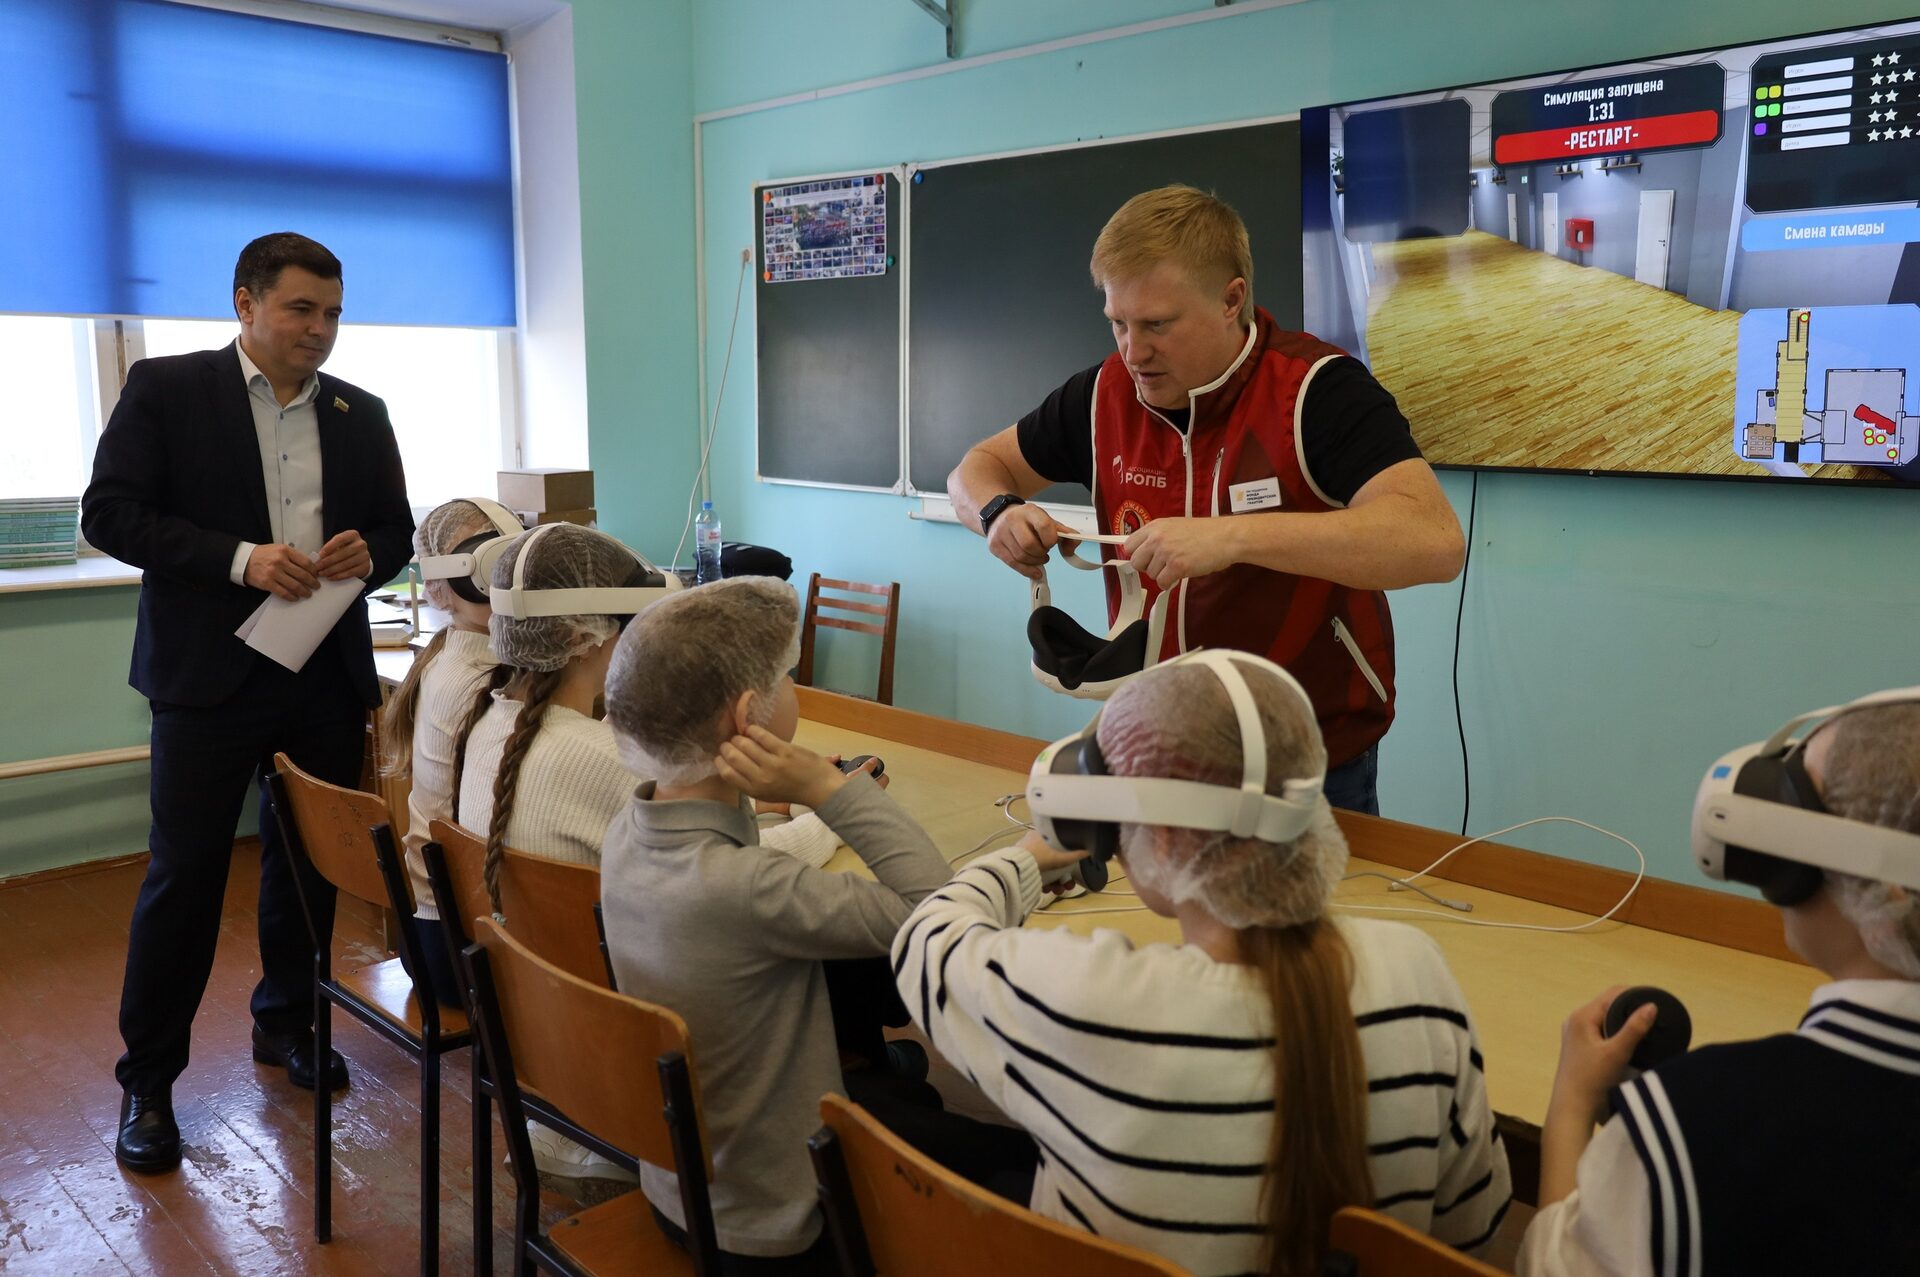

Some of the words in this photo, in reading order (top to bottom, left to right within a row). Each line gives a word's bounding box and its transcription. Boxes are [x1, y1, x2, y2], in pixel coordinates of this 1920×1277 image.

[1543, 87, 1605, 107] Симуляция
[1607, 79, 1664, 98] запущена
[1588, 101, 1615, 122] 1:31
[1564, 125, 1639, 150] -РЕСТАРТ-
[1784, 226, 1826, 240] Смена
[1830, 222, 1885, 238] камеры
[1125, 472, 1167, 488] РОПБ
